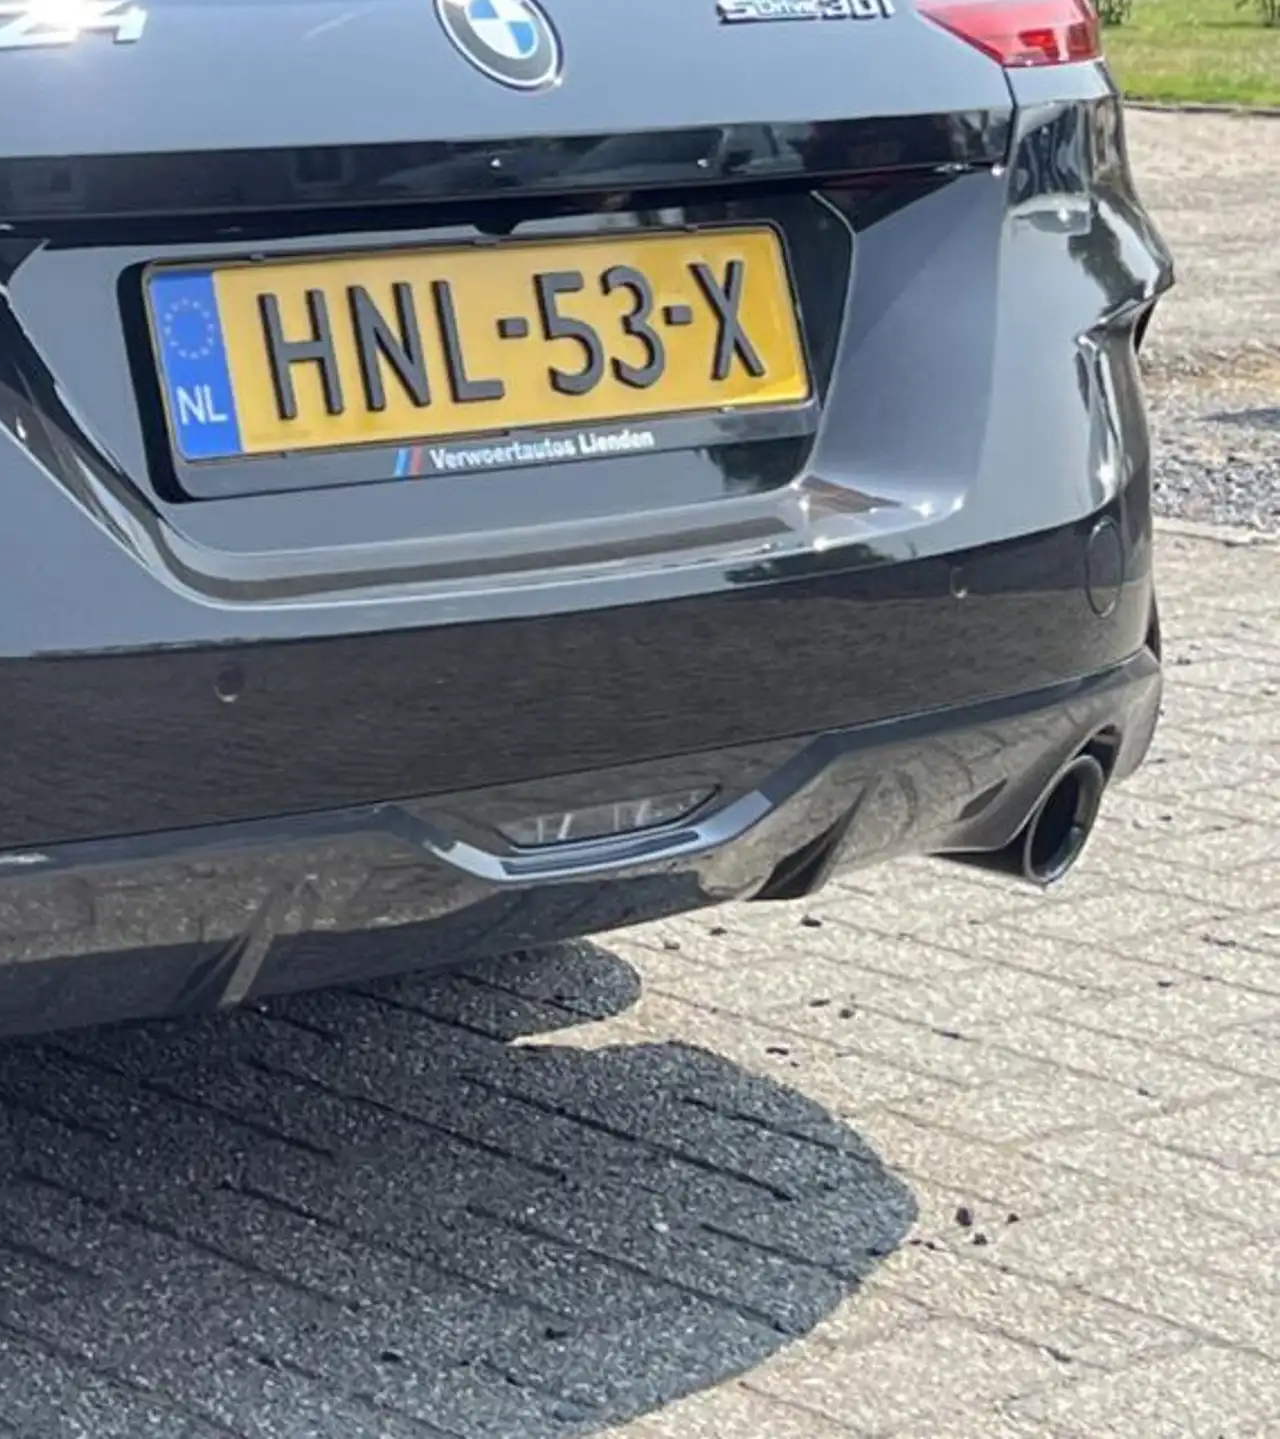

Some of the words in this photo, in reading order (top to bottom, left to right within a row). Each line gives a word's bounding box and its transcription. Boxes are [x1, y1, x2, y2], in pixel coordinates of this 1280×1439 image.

[257, 259, 766, 421] HNL-53-X
[177, 386, 228, 426] NL
[429, 437, 576, 469] Verwoertautos
[578, 430, 655, 454] Lienden
